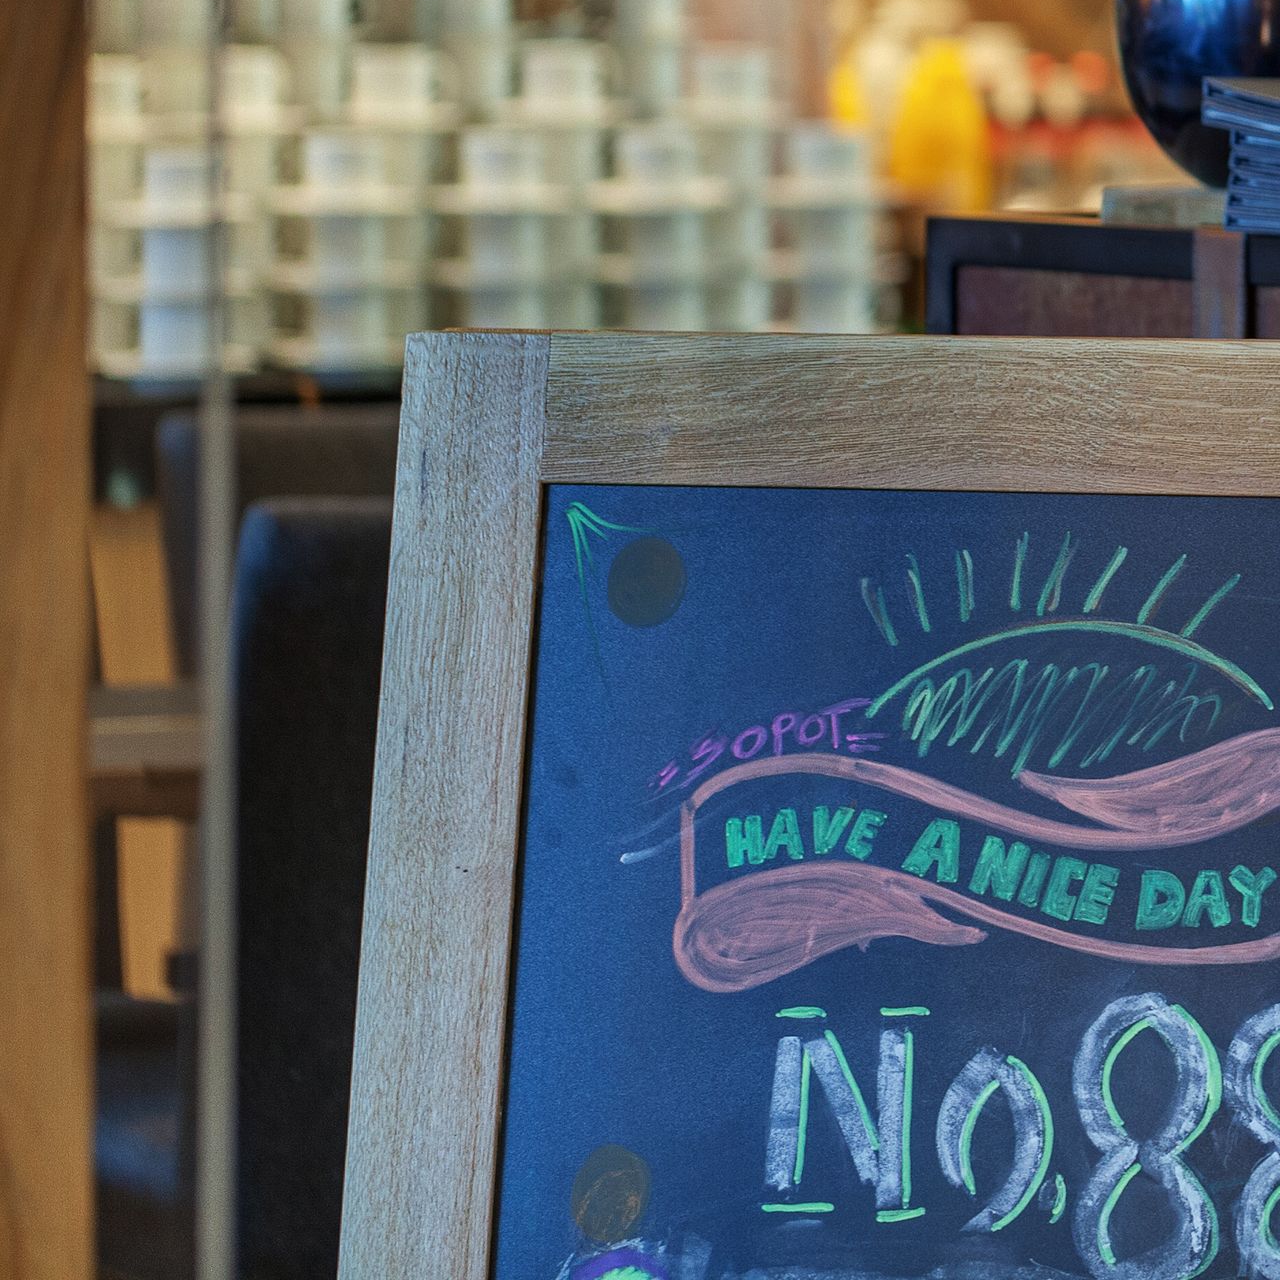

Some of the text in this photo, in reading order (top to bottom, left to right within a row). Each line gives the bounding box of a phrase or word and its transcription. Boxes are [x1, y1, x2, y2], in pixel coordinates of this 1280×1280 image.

[725, 805, 1279, 931] HAVE A NICE DAY
